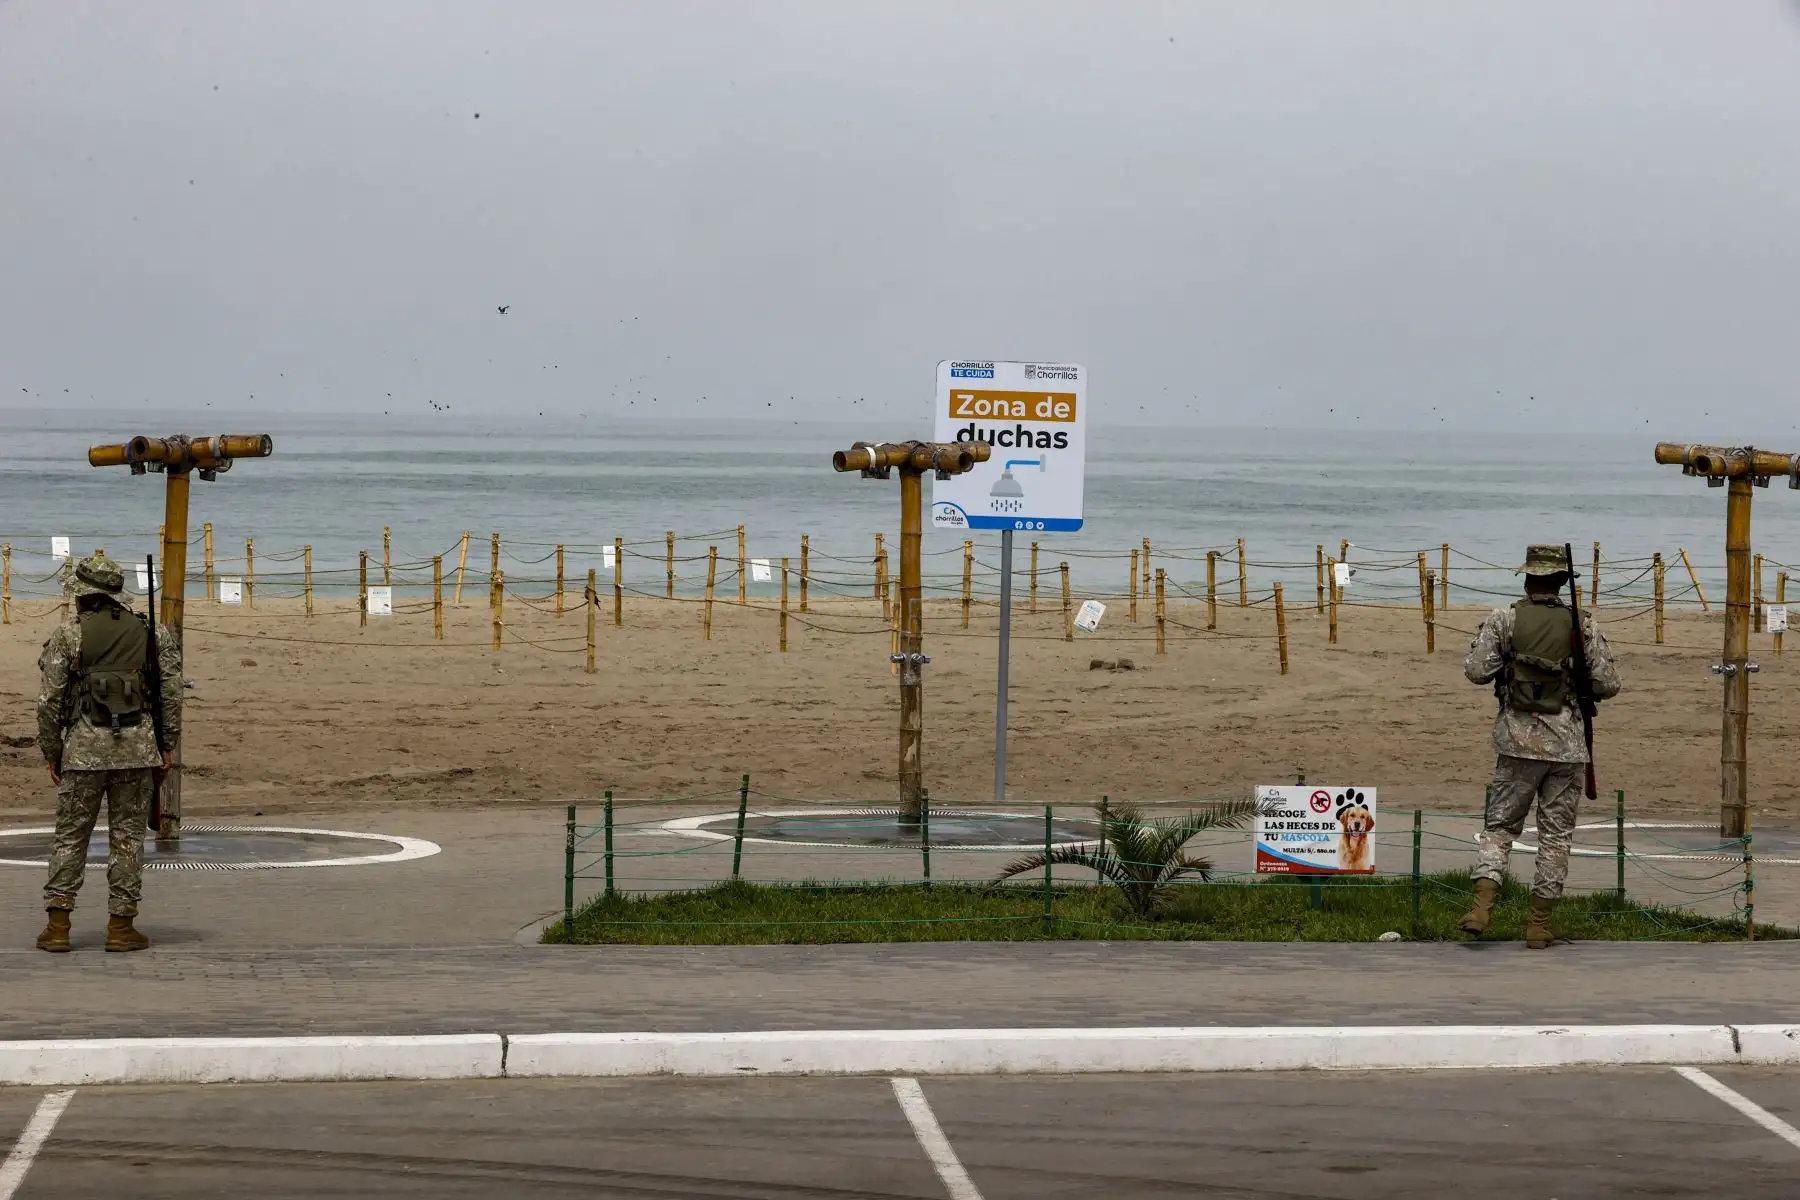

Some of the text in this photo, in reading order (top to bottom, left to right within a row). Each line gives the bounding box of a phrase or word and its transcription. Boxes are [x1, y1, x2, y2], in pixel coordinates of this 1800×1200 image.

[951, 361, 995, 369] CHORRILLOS
[953, 369, 993, 378] TE CUIDA
[1037, 371, 1078, 380] Chorrillos
[956, 394, 1070, 418] Zona de
[956, 422, 1069, 449] duchas
[1264, 821, 1336, 831] LAS HECES DE
[1264, 833, 1330, 842] TU MASCOTA
